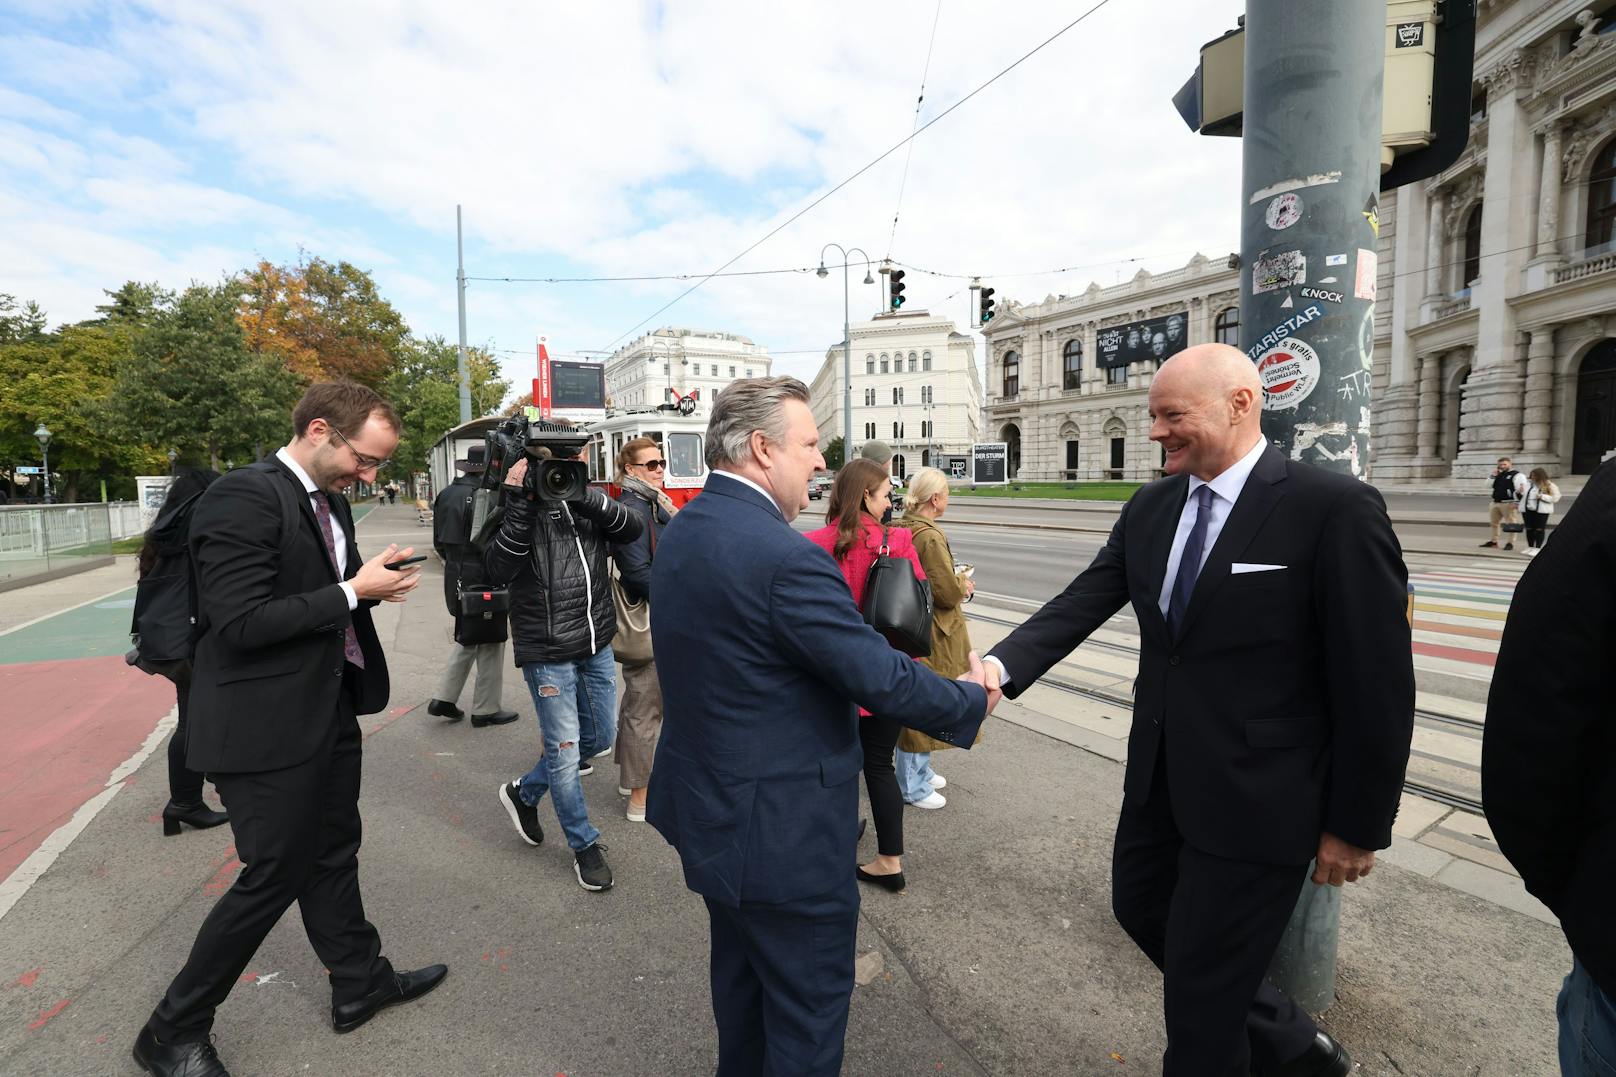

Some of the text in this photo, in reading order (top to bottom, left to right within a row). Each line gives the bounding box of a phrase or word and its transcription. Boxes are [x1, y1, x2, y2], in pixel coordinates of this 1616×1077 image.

[1301, 287, 1343, 303] KNOCK
[1098, 335, 1124, 347] NICHT
[1290, 342, 1313, 361] gratis
[1266, 369, 1302, 384] Vermehrt
[1271, 391, 1295, 401] Public
[680, 398, 695, 411] WTM
